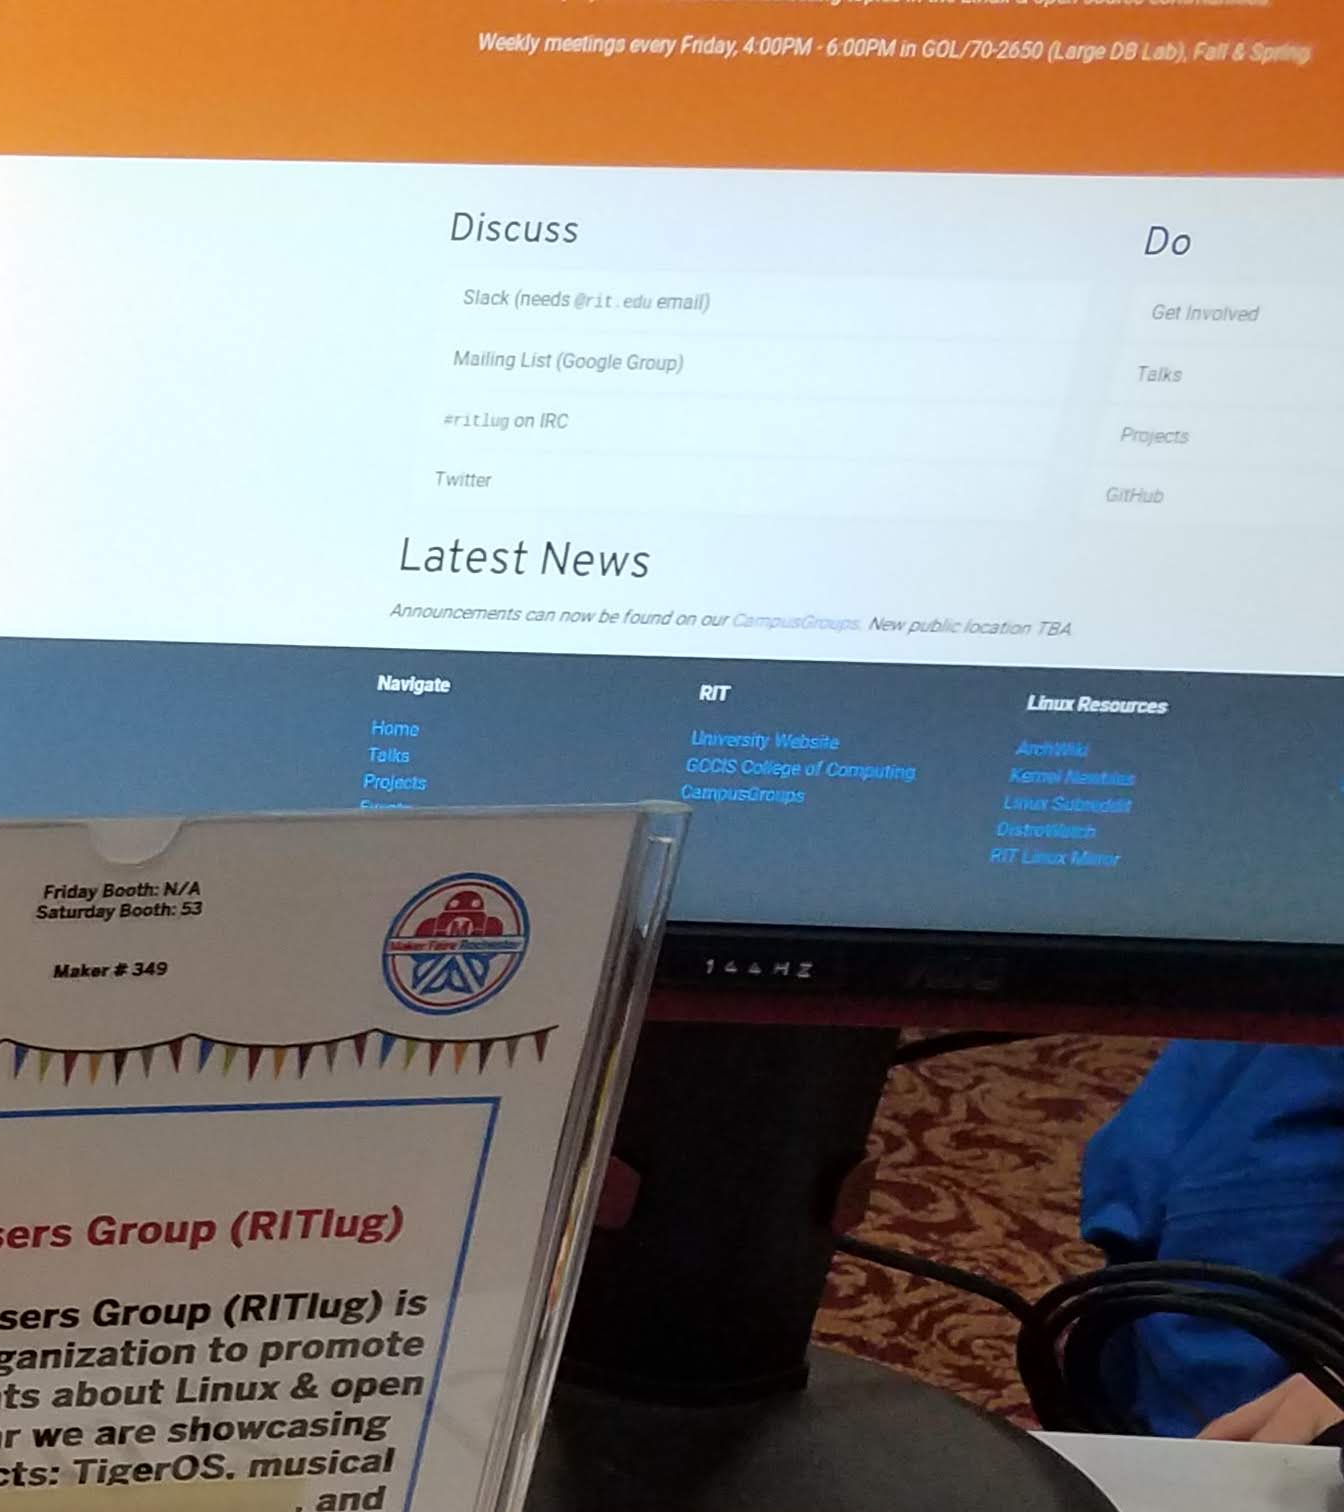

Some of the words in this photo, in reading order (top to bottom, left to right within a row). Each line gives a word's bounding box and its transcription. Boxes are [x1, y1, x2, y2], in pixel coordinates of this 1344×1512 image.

[478, 32, 540, 55] Weekly
[544, 35, 625, 56] meetings
[629, 38, 677, 57] every
[680, 36, 738, 58] Friday,
[743, 37, 811, 56] 4:00PM
[827, 37, 896, 57] 6:00PM
[900, 39, 916, 57] in
[922, 40, 1043, 60] GOL/70-2650
[1048, 41, 1106, 62] (Large
[1111, 43, 1137, 60] DB
[450, 212, 579, 243] Discuss
[1144, 226, 1191, 256] Do
[463, 289, 509, 305] Slack
[515, 290, 570, 309] (needs
[656, 293, 711, 314] email)
[1151, 304, 1180, 320] Get
[1186, 304, 1260, 321] Involved
[453, 350, 515, 371] Mailing
[521, 352, 551, 368] List
[556, 352, 622, 373] (Google
[626, 354, 684, 374] Group)
[1137, 365, 1183, 382] Talks
[443, 413, 509, 430] #ritlug
[514, 415, 534, 428] on
[540, 413, 569, 429] IRC
[1120, 426, 1189, 446] Projects
[436, 471, 492, 487] Twitter
[1106, 487, 1164, 504] GitHub
[400, 537, 528, 575] Latest
[540, 541, 651, 578] News
[389, 603, 522, 622] Announcements
[525, 608, 555, 622] can
[559, 610, 594, 623] now
[599, 608, 618, 623] be
[622, 608, 671, 625] found
[676, 613, 696, 625] on
[701, 614, 729, 627] our
[869, 616, 903, 633] New
[908, 616, 960, 635] public
[964, 619, 1032, 635] location
[1038, 621, 1072, 636] TBA
[377, 675, 451, 695] Navigate
[699, 684, 731, 701] RIT
[1027, 695, 1074, 711] Linux
[1077, 696, 1169, 714] Resources
[371, 720, 420, 737] Home
[692, 730, 769, 750] University
[775, 733, 840, 750] Website
[368, 747, 410, 763] Talks
[741, 759, 800, 778] College
[806, 760, 823, 777] of
[828, 762, 916, 782] Computing
[363, 774, 427, 791] Projects
[44, 884, 98, 902] Friday
[104, 883, 159, 898] Booth:
[164, 881, 201, 897] N/A
[36, 902, 114, 921] Saturday
[119, 902, 176, 918] Booth:
[181, 901, 202, 917] 53
[54, 962, 109, 979] Maker
[114, 963, 128, 977] #
[133, 961, 168, 977] 349
[87, 1213, 216, 1250] Group
[229, 1204, 405, 1250] (RITlug)
[93, 1295, 212, 1330] Group
[223, 1289, 384, 1330] (RITlug)
[394, 1288, 429, 1318] is
[208, 1338, 249, 1365] to
[258, 1332, 425, 1369] promote
[52, 1377, 165, 1411] about
[175, 1374, 279, 1405] Linux
[289, 1373, 318, 1400] &
[330, 1372, 426, 1405] open
[33, 1424, 84, 1449] we
[95, 1418, 157, 1447] are
[167, 1410, 393, 1450] showcasing
[248, 1447, 397, 1480] musical
[315, 1485, 386, 1512] and
